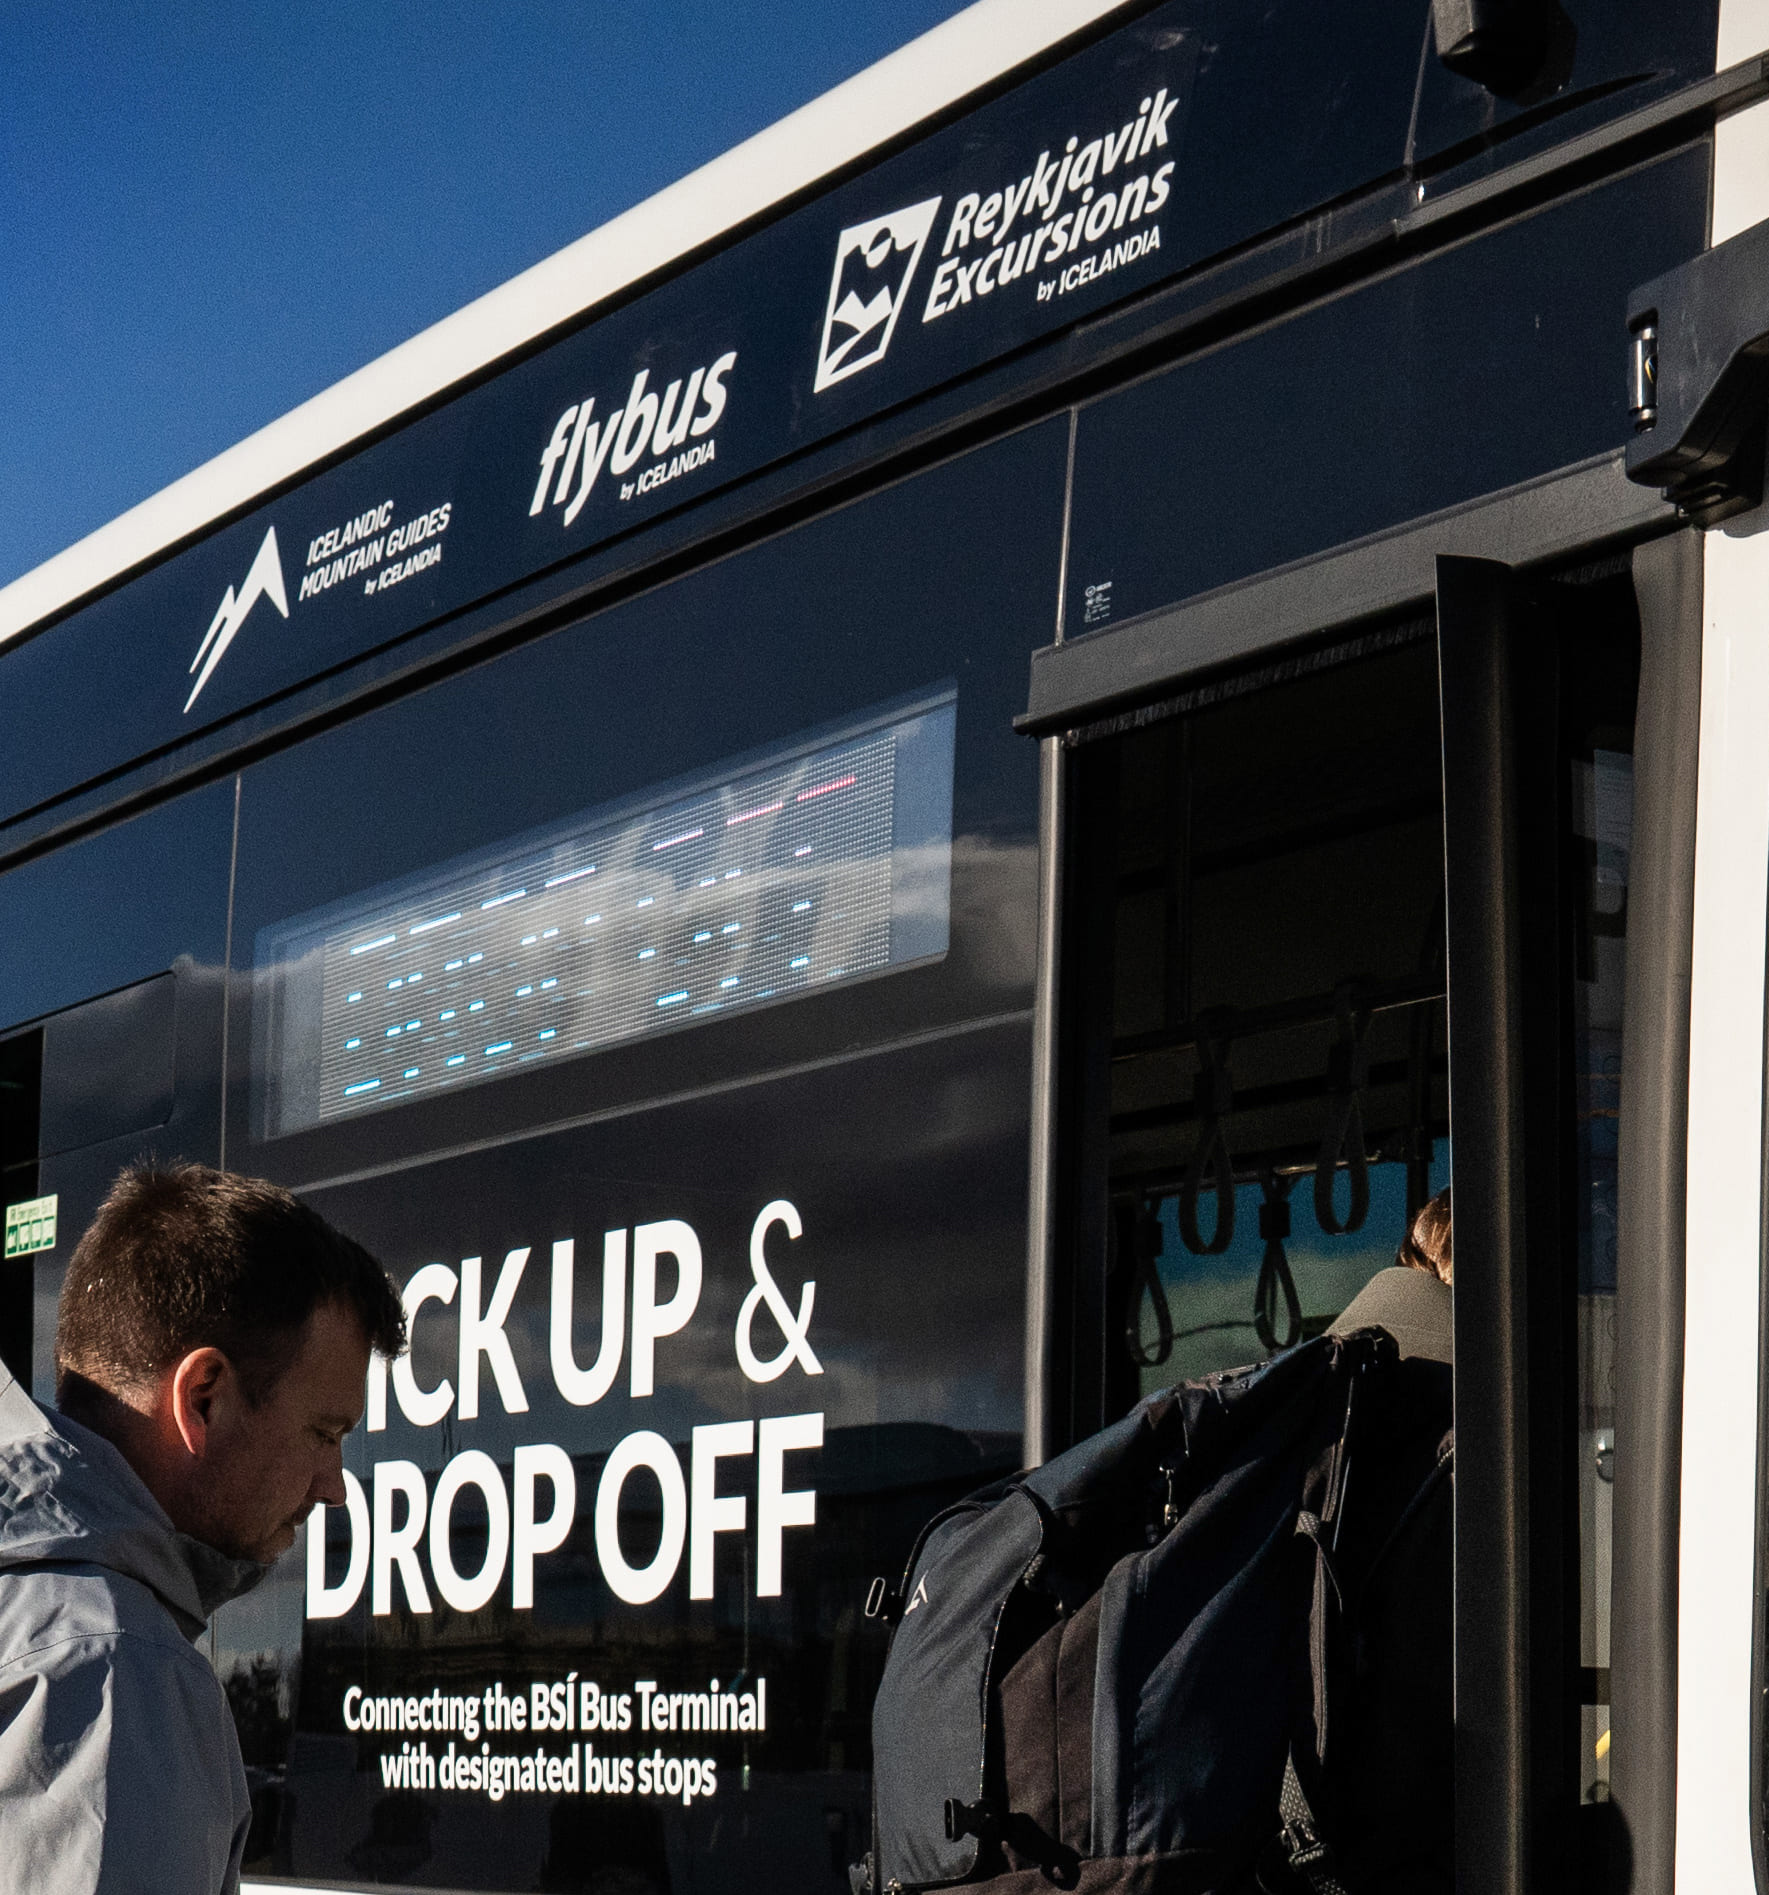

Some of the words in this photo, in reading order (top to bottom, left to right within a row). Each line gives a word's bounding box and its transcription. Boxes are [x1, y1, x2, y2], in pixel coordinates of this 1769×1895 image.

[941, 87, 1180, 257] Reykjavik
[922, 161, 1175, 323] Excursions
[1037, 281, 1056, 301] by
[1058, 225, 1160, 294] ICELANDIA
[529, 351, 737, 527] flybus
[620, 483, 635, 500] by
[636, 439, 715, 495] ICELANDIA
[299, 536, 385, 601] MOUNTAIN
[385, 502, 452, 557] GUIDES
[306, 500, 394, 566] ICELANDIC
[364, 579, 377, 595] by
[378, 543, 441, 591] ICELANDIA
[367, 1246, 532, 1432] ICK
[549, 1219, 702, 1406] UP
[735, 1199, 824, 1383] &
[306, 1443, 576, 1619] DROP
[595, 1412, 824, 1604] OFF
[343, 1685, 480, 1741] Connecting
[484, 1682, 527, 1731] the
[531, 1672, 579, 1731] BSÍ
[580, 1682, 631, 1732] Bus
[635, 1678, 766, 1731] Terminal
[380, 1742, 435, 1789] with
[439, 1742, 580, 1801] designated
[585, 1743, 633, 1794] bus
[637, 1748, 717, 1806] stops
